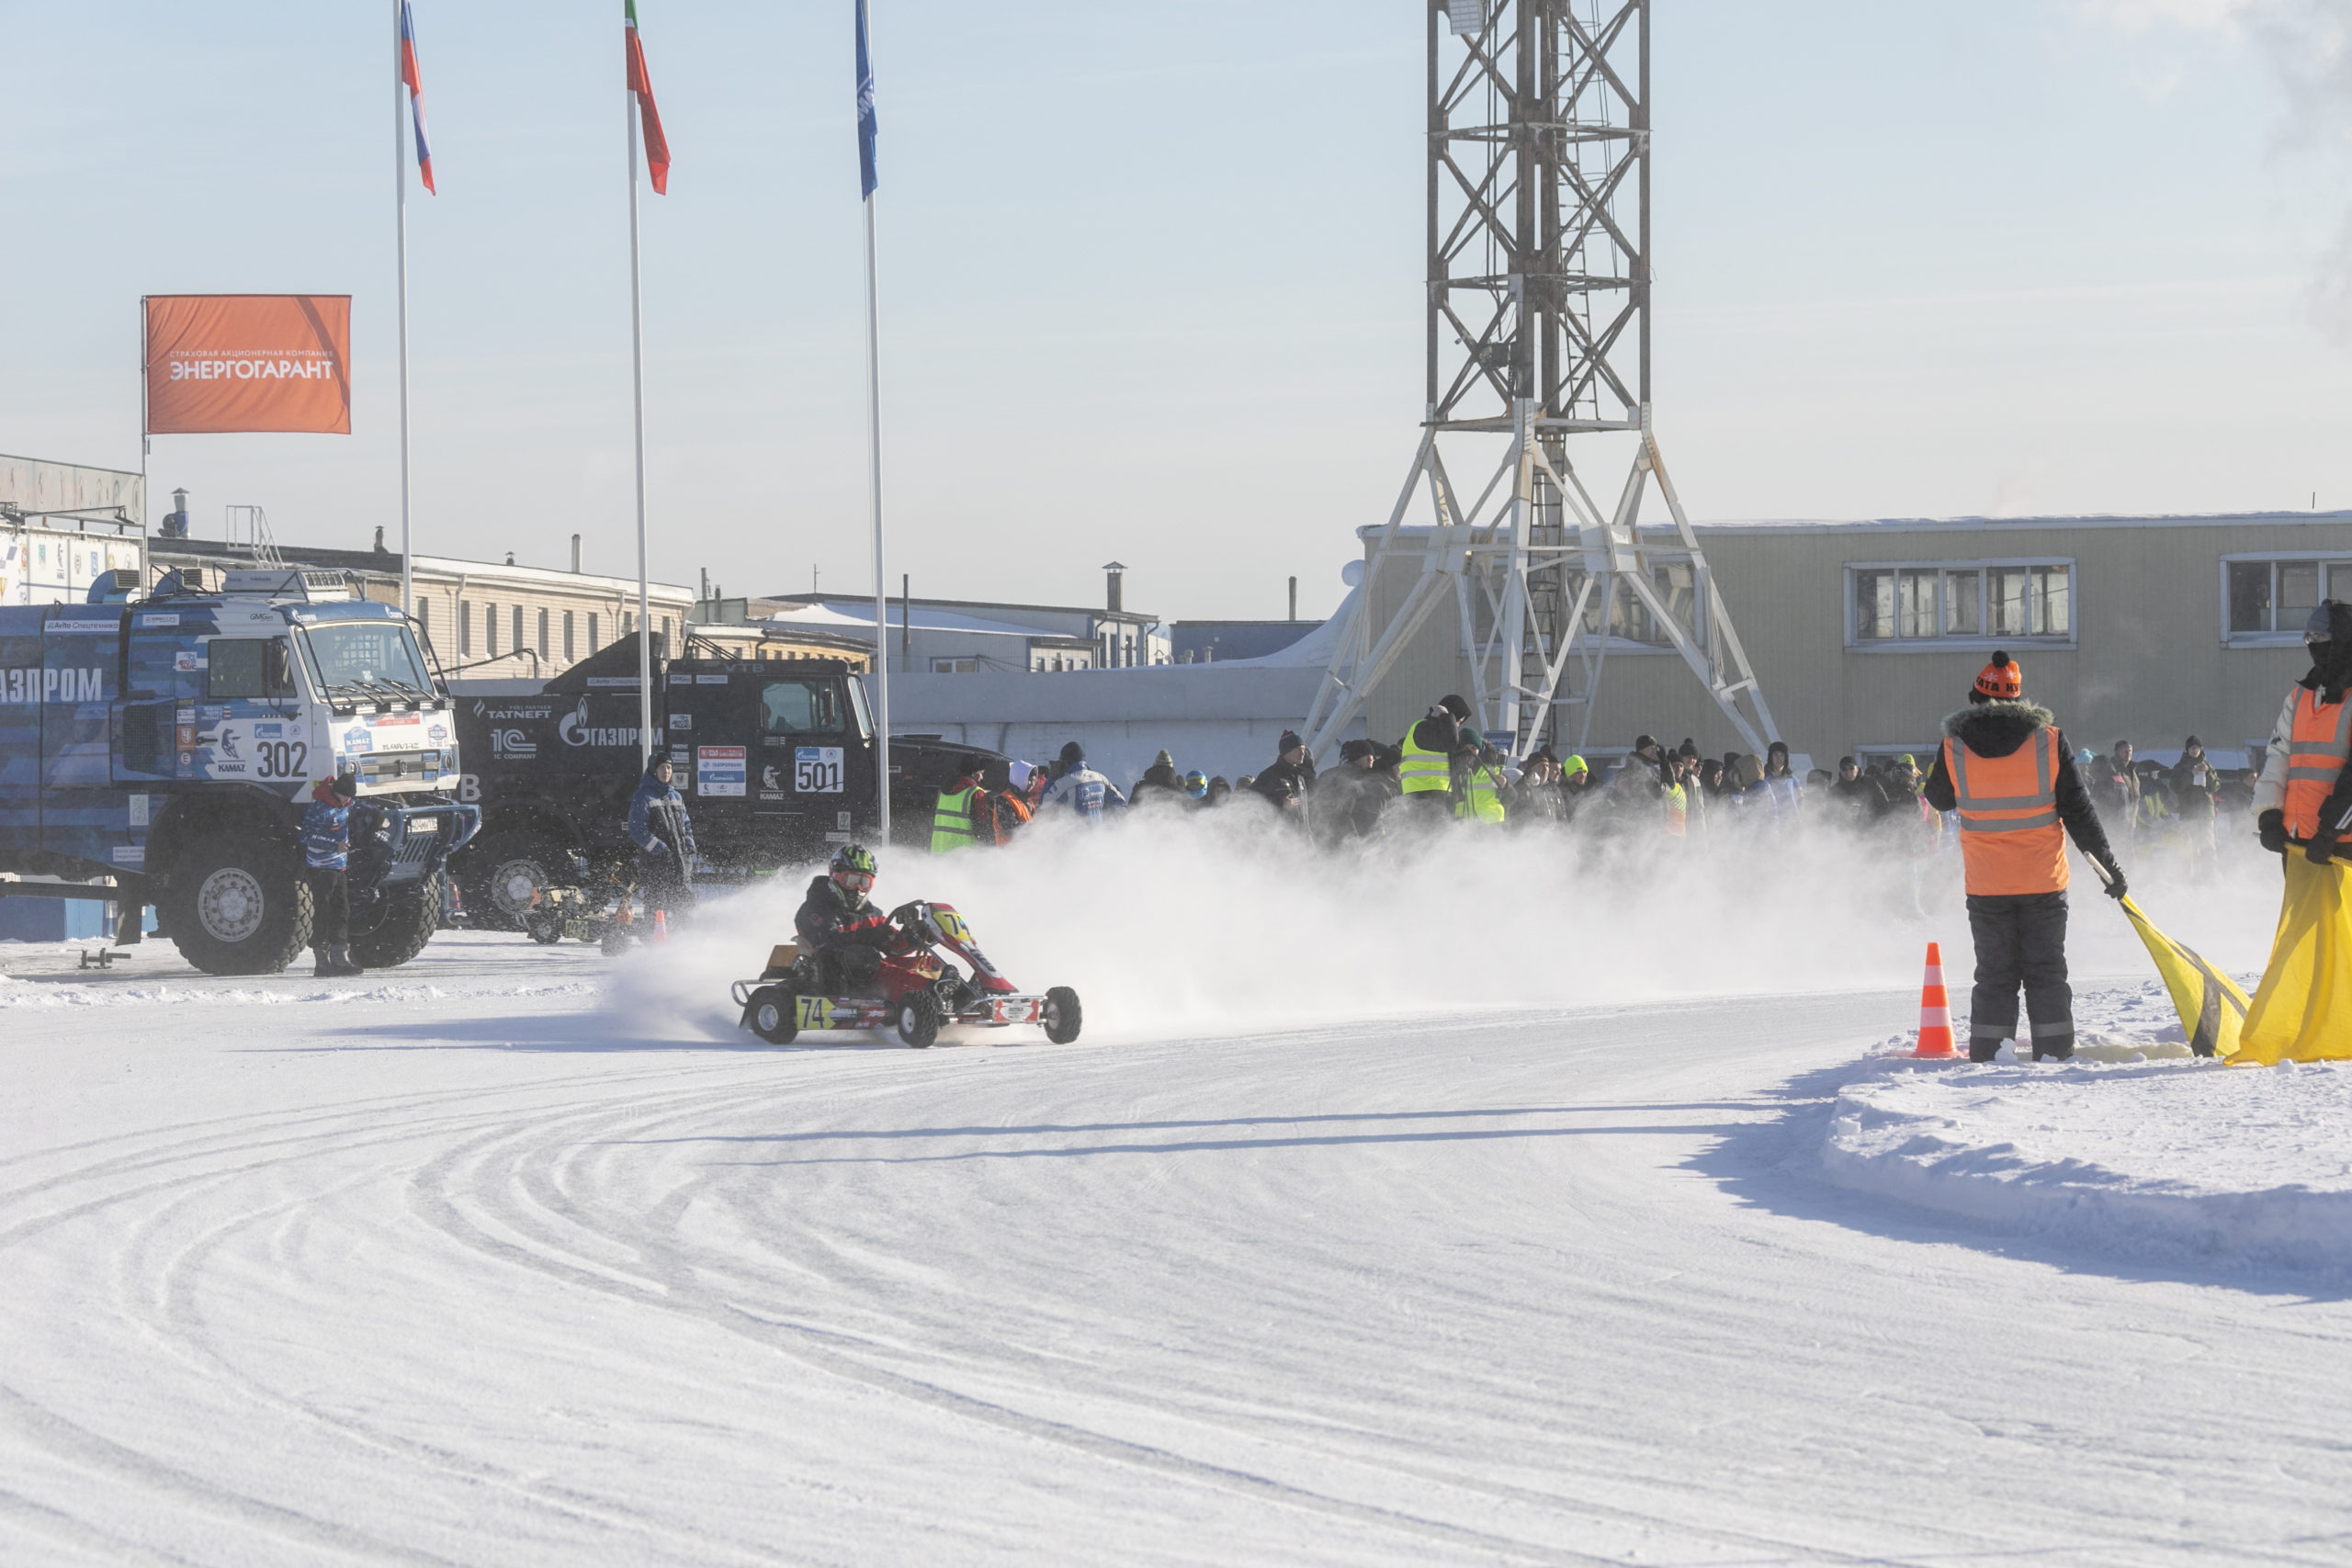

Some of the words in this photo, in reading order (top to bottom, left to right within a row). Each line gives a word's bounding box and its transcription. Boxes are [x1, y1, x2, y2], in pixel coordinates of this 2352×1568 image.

[169, 350, 219, 358] СТРАХОВАЯ
[169, 359, 334, 380] ЭНЕРГОГАРАНТ
[723, 662, 765, 673] VTB
[487, 710, 552, 719] TATNEFT
[256, 740, 308, 778] 302
[218, 763, 246, 773] KAMAZ
[797, 761, 838, 791] 501
[760, 792, 785, 801] KAMAZ
[944, 914, 971, 937] 74
[800, 998, 825, 1029] 74
